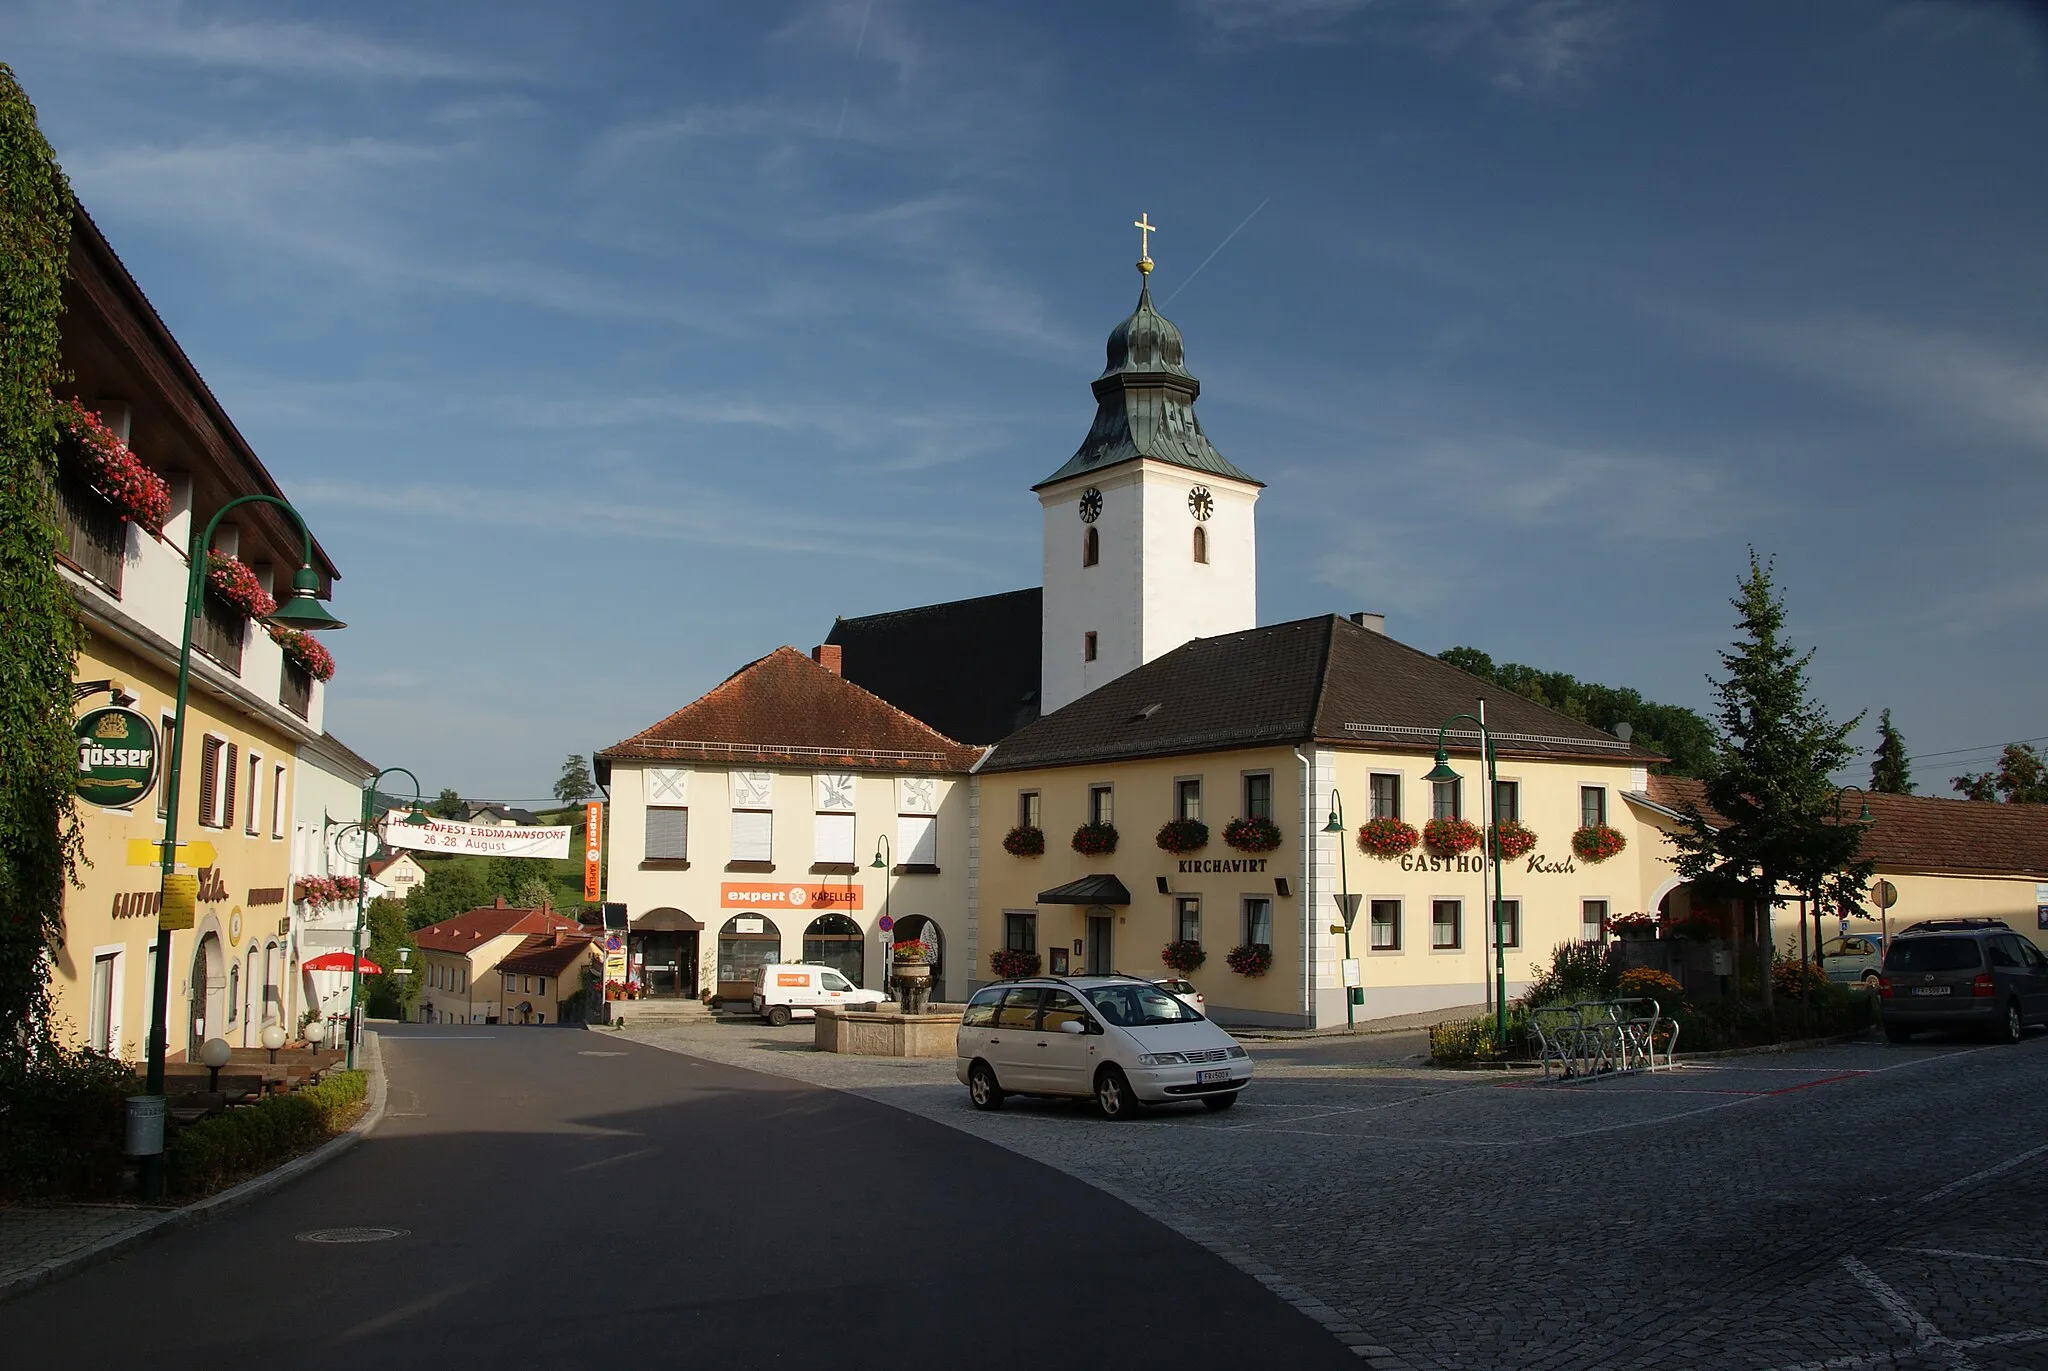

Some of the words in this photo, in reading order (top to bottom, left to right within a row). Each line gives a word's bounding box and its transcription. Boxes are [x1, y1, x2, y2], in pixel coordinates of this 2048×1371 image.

[470, 827, 567, 840] ERDMANNSDORF
[590, 807, 598, 848] expert
[465, 839, 507, 852] August
[1178, 859, 1268, 873] KIRCHAWIRT
[1526, 854, 1577, 874] Resch
[727, 891, 786, 902] expert
[811, 892, 857, 902] KAPELLER
